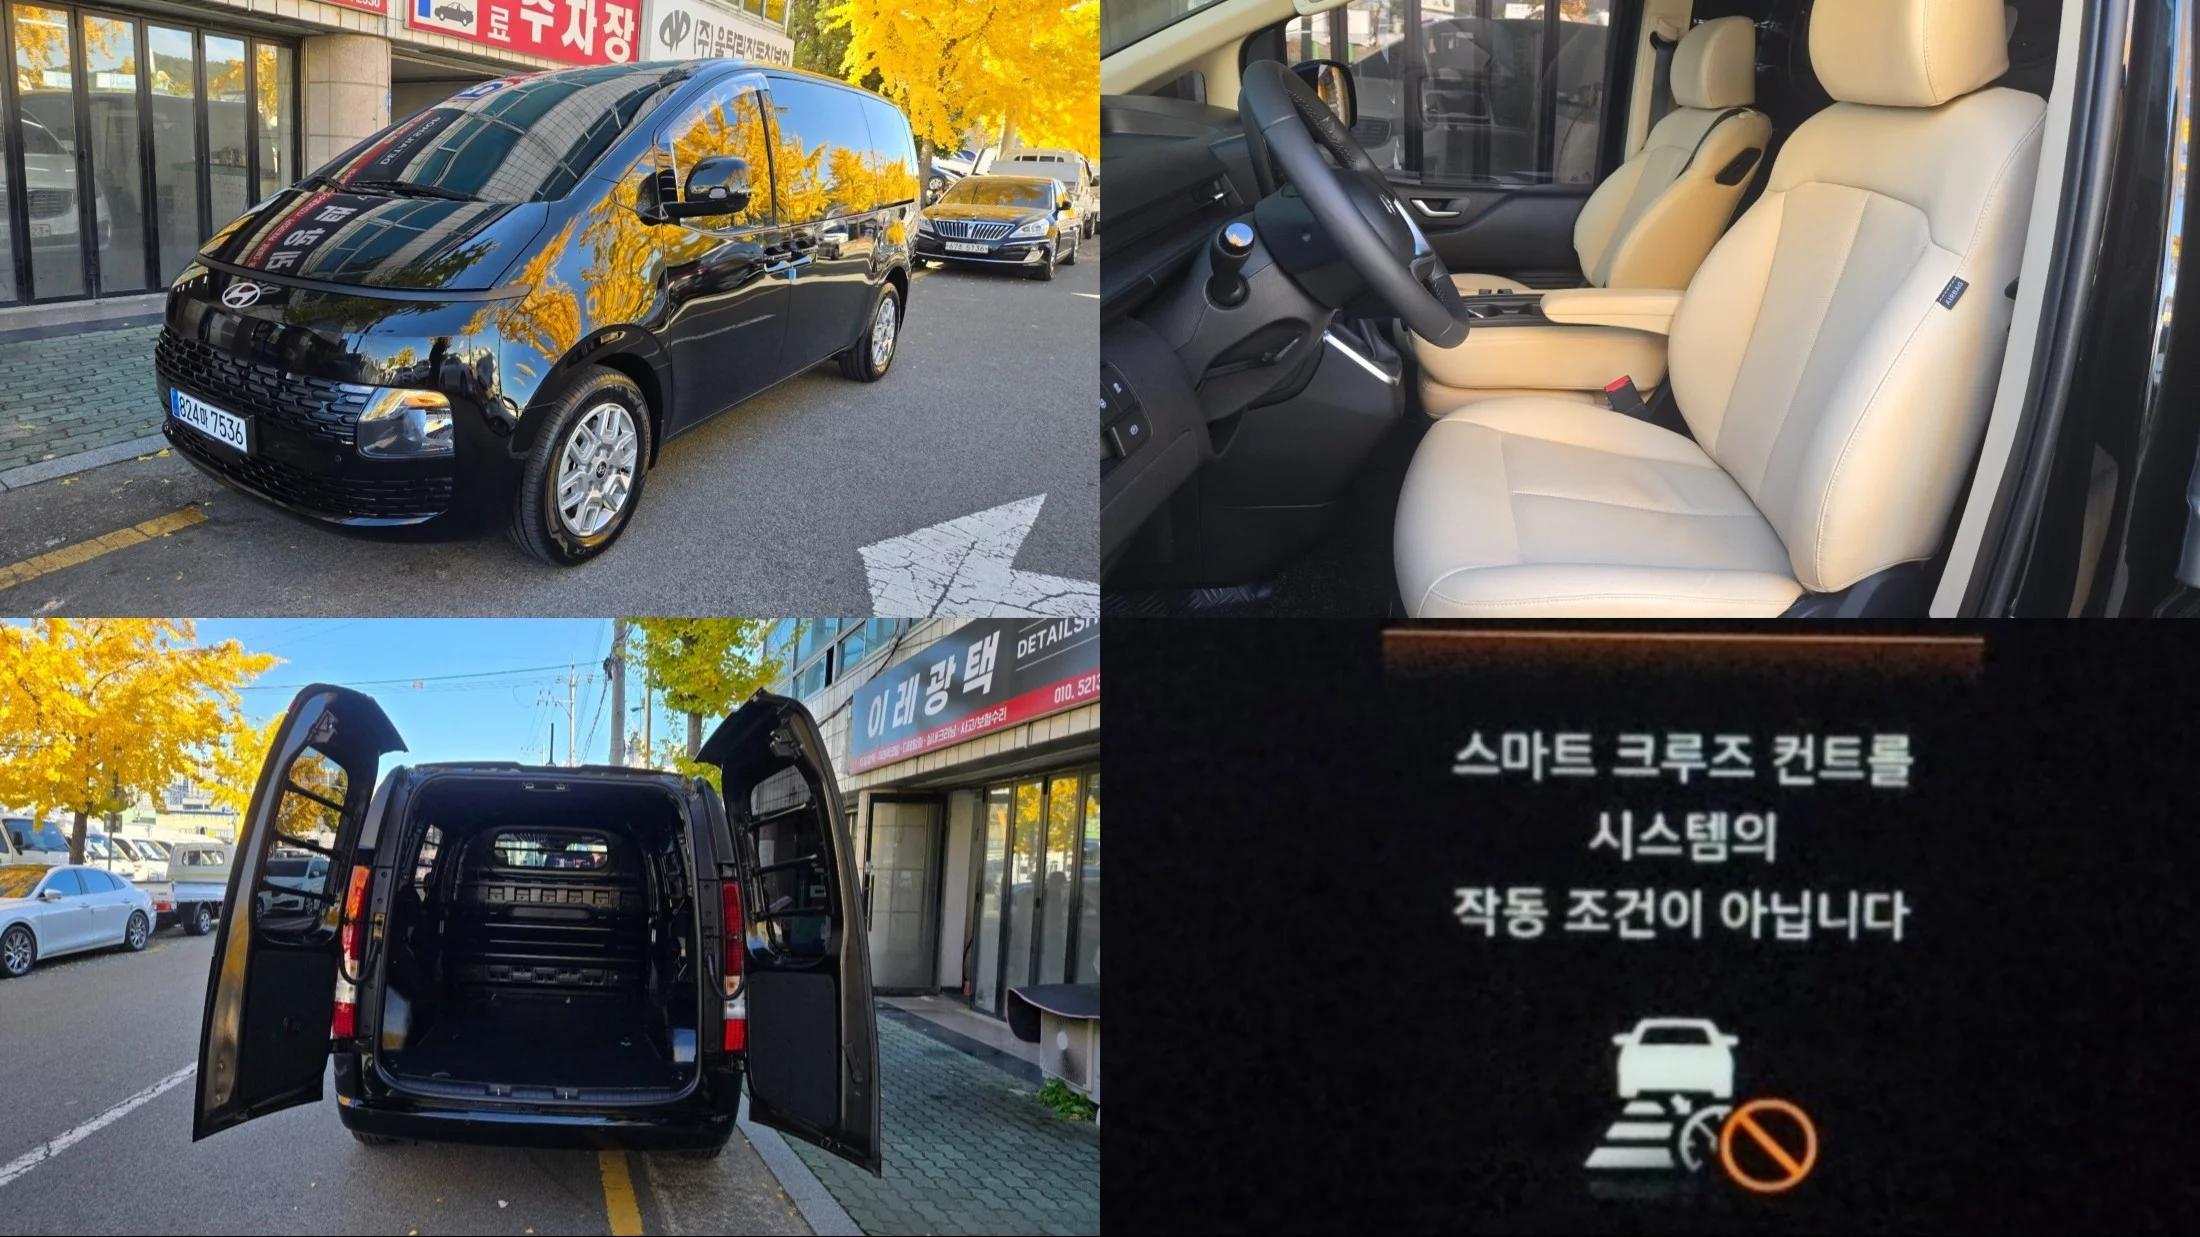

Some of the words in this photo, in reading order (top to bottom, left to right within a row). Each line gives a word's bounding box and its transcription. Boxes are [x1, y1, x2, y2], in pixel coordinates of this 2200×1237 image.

[210, 411, 244, 445] 7536
[1452, 730, 1597, 782] 스마트
[1612, 732, 1756, 784] 크루즈
[1588, 809, 1777, 862] 시스템의
[1453, 886, 1548, 938] 작동
[1563, 888, 1704, 940] 조건이
[1721, 890, 1911, 942] 아닙니다
